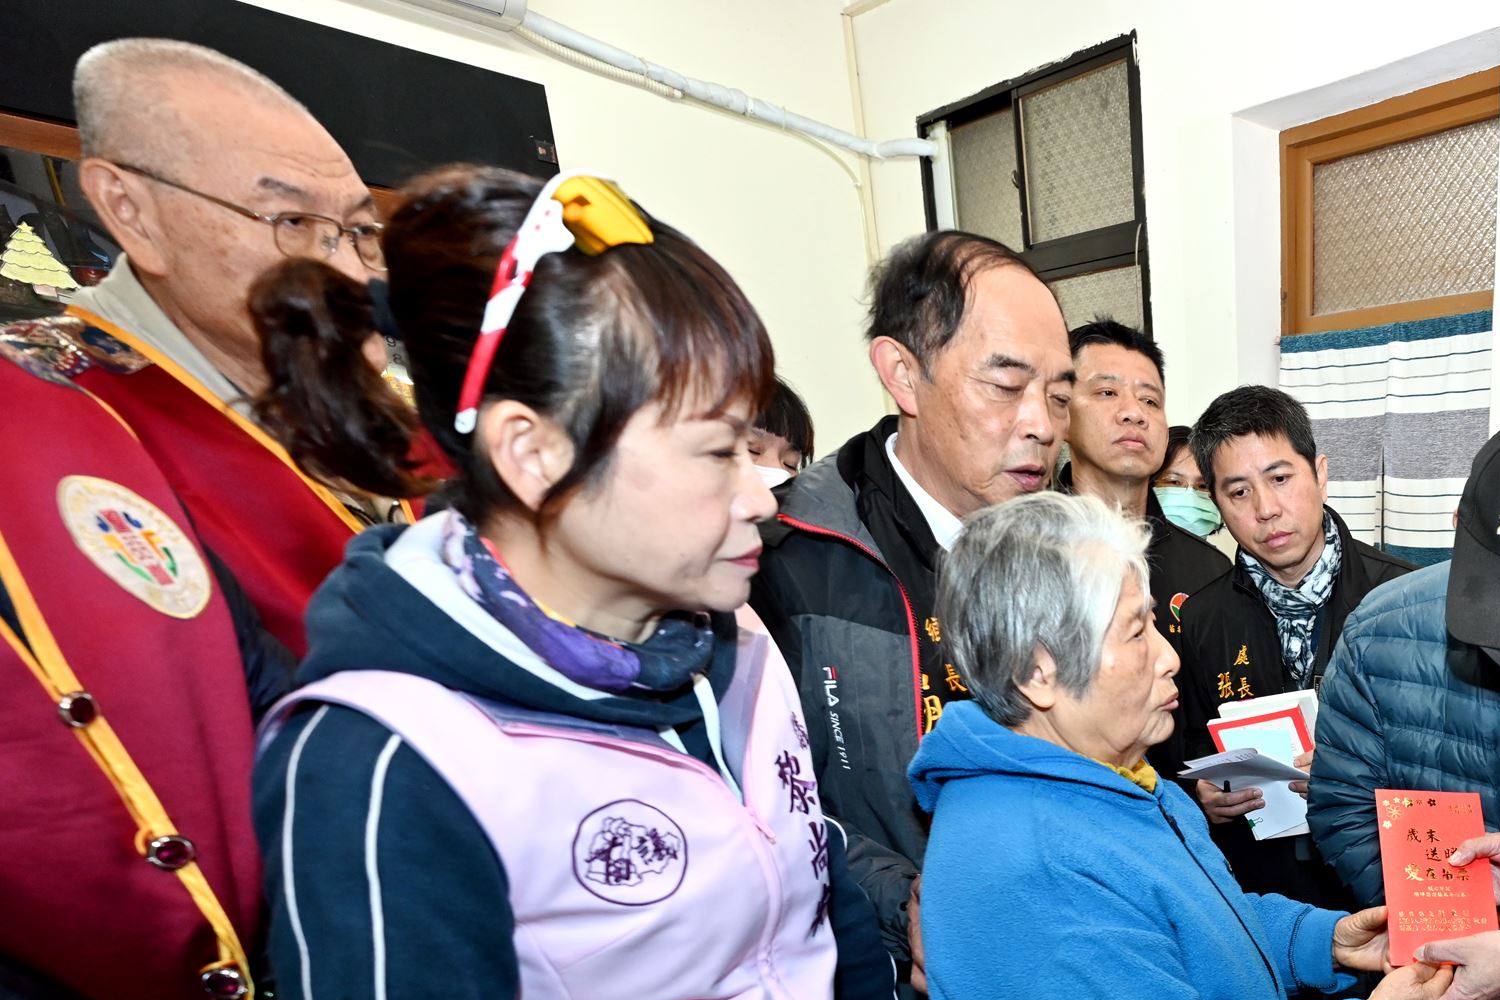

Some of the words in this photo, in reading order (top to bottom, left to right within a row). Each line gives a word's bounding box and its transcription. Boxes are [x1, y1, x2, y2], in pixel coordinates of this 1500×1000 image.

[822, 665, 840, 707] FILA
[829, 711, 845, 744] SINCE
[837, 745, 852, 770] 1911
[1406, 828, 1441, 843] 歲末
